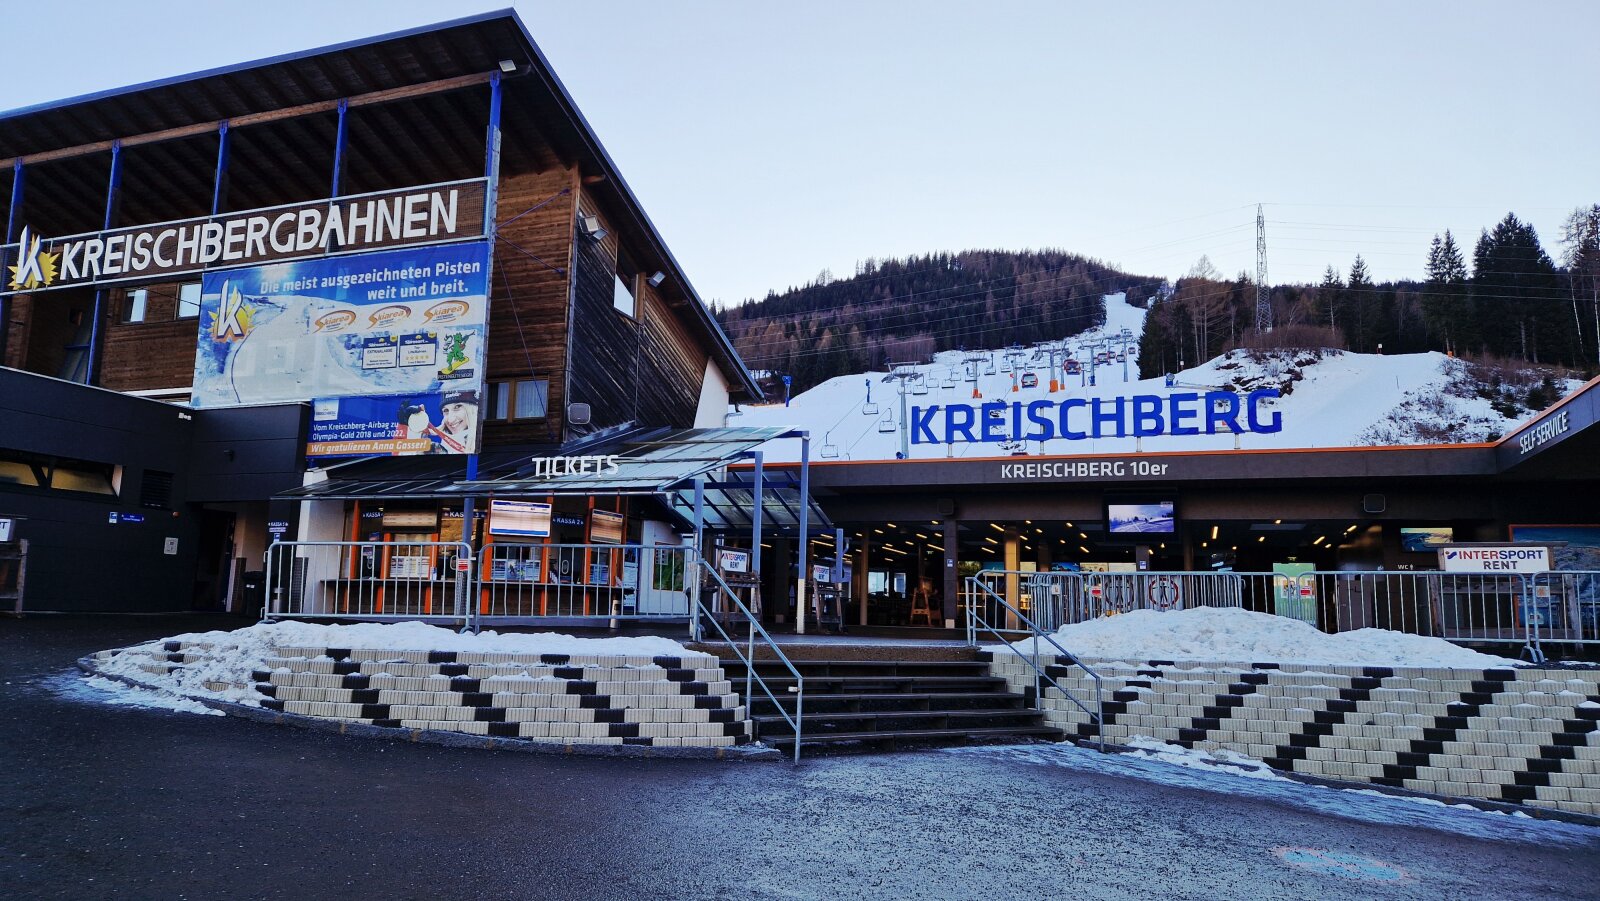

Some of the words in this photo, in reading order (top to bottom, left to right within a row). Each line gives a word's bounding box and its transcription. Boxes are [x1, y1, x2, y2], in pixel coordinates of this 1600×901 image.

[60, 190, 458, 280] KREISCHBERGBAHNEN
[260, 281, 280, 294] Die
[283, 277, 317, 291] meist
[321, 267, 431, 289] ausgezeichneten
[436, 262, 480, 276] Pisten
[367, 286, 396, 300] weit
[400, 283, 426, 297] und
[431, 280, 468, 295] breit.
[911, 388, 1282, 444] KREISCHBERG
[313, 430, 354, 441] Olympia-Gold
[356, 430, 371, 438] 2018
[372, 429, 385, 438] und
[387, 430, 405, 438] 2022.
[328, 422, 389, 431] Kreischberg-Airbag
[1520, 430, 1536, 455] SELF
[1537, 411, 1568, 446] SERVICE
[311, 444, 326, 453] Wir
[326, 442, 372, 453] gratulieren
[373, 442, 394, 451] Anna
[396, 441, 427, 450] Gasser!
[532, 455, 619, 477] TICKETS
[1001, 461, 1125, 479] KREISCHBERG
[1130, 460, 1169, 477] 10er
[557, 517, 576, 525] KASSA
[1459, 549, 1543, 560] INTERSPORT
[1483, 560, 1518, 570] RENT
